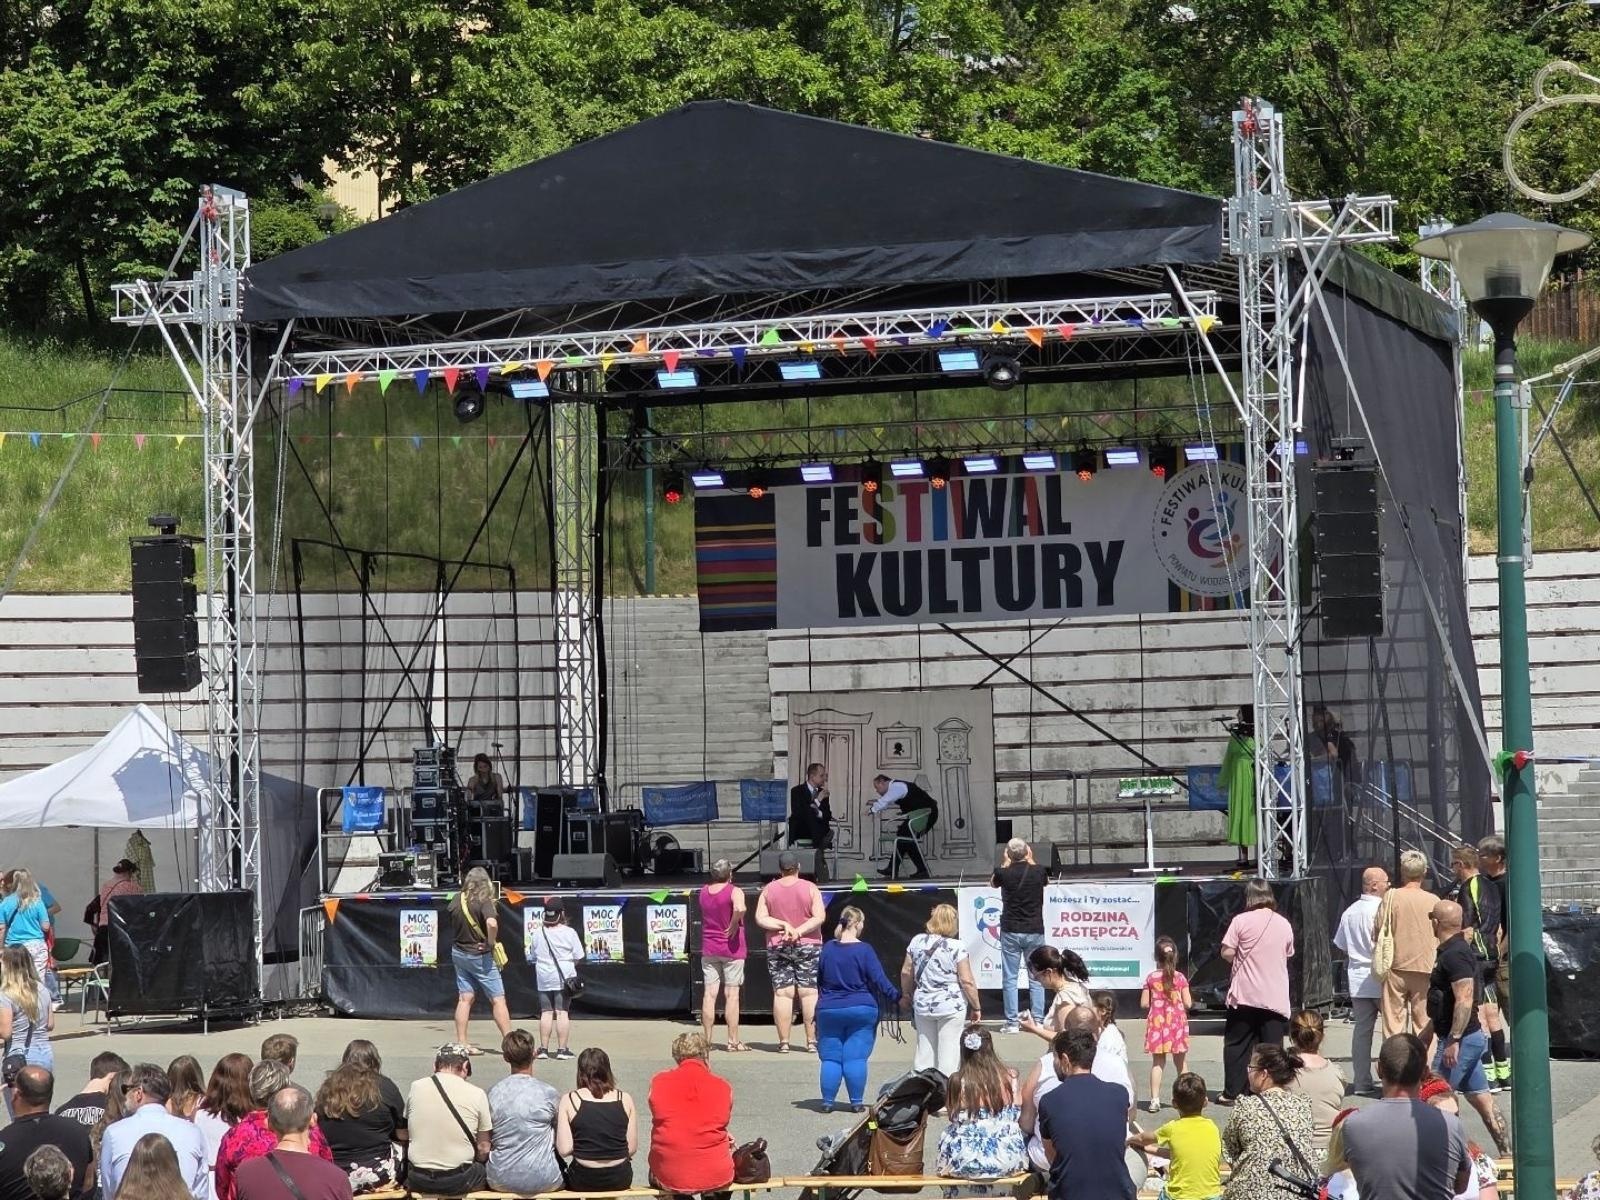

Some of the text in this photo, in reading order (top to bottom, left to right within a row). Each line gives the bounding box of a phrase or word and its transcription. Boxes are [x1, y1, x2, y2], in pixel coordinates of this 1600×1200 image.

[1161, 472, 1215, 526] FESTIWAL
[806, 474, 1072, 547] FESTIWAL
[836, 540, 1125, 618] KULTURY
[1049, 895, 1082, 904] Możesz
[1090, 896, 1100, 905] Ty
[408, 913, 430, 924] MOC
[591, 909, 614, 919] MOC
[655, 908, 678, 919] MOC
[1060, 911, 1130, 926] RODZINĄ
[1051, 926, 1140, 941] ZASTĘPCZĄ
